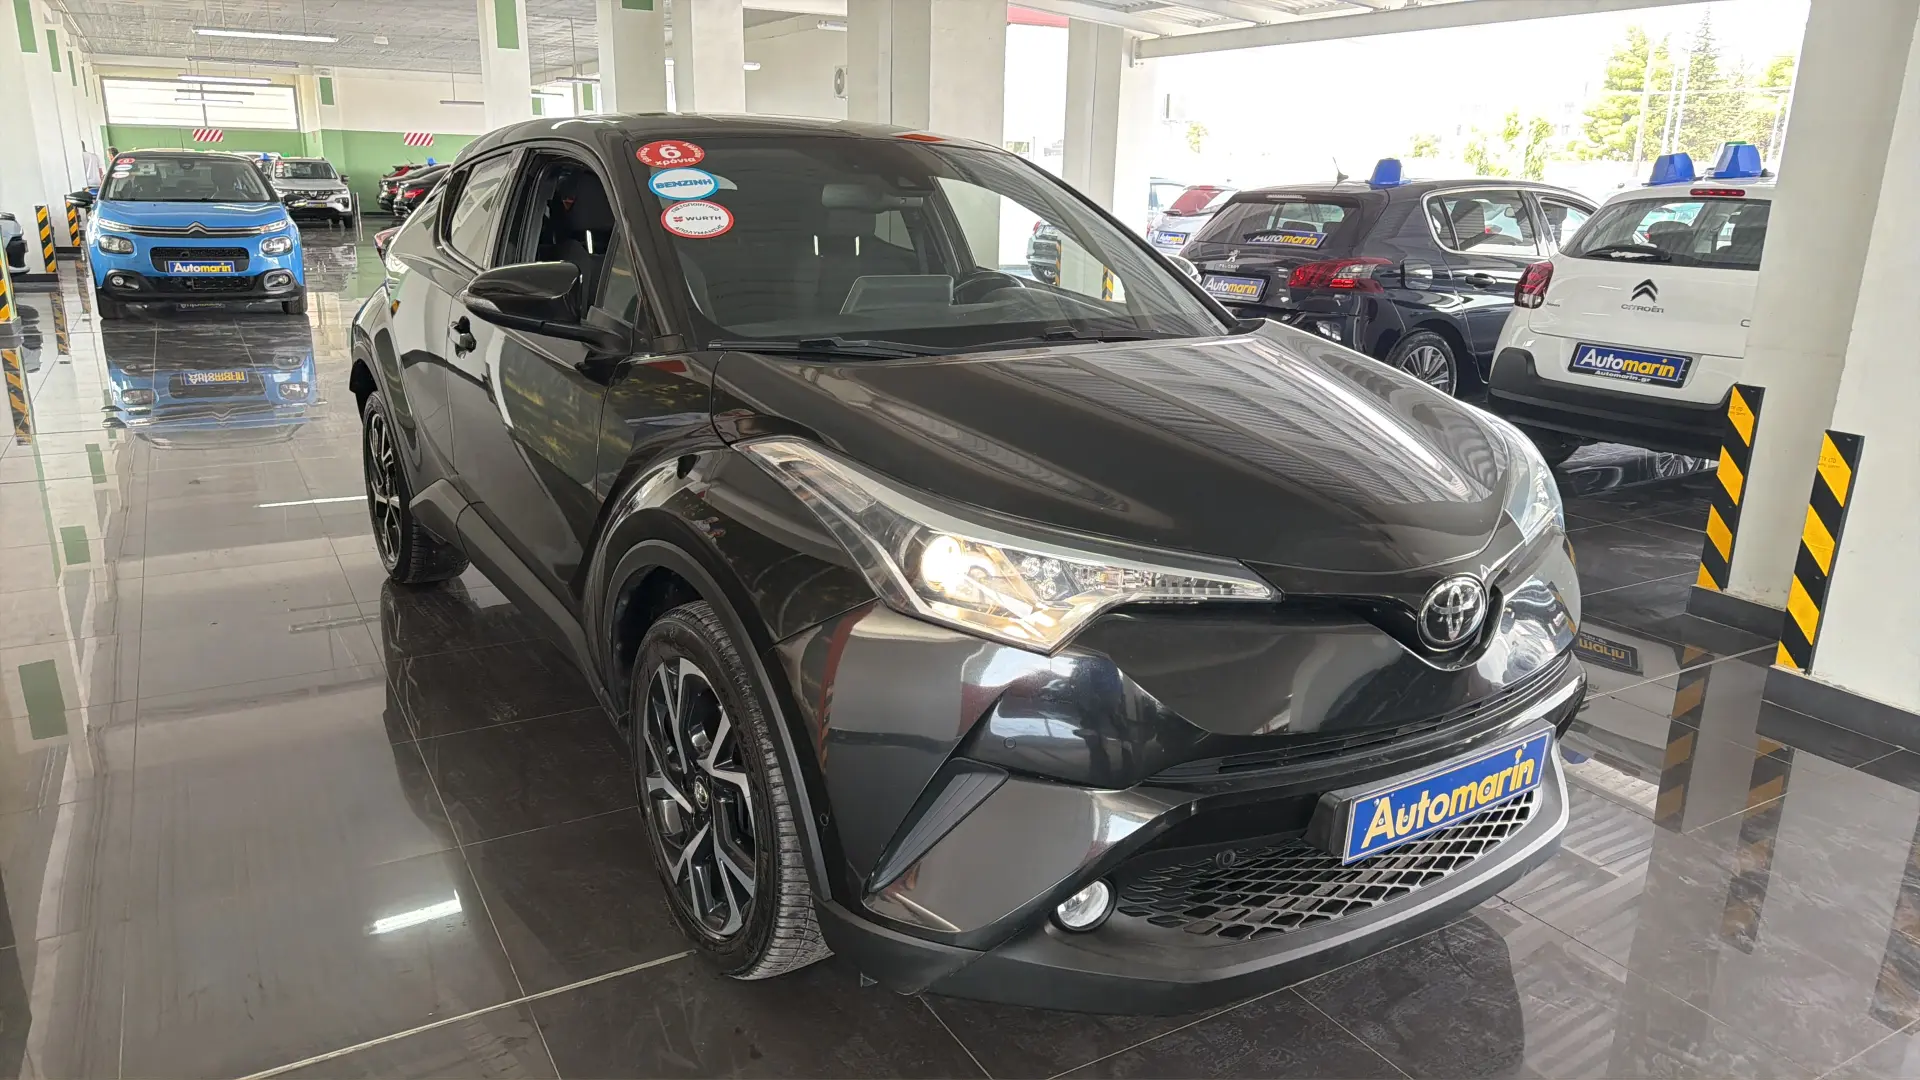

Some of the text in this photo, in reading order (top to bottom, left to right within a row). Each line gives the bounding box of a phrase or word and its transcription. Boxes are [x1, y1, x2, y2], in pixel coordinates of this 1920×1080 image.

[659, 146, 681, 159] 6
[655, 157, 697, 166] χρόνια
[1252, 233, 1318, 246] Automarin
[173, 262, 232, 273] Automarin
[1204, 276, 1258, 295] Automarin
[1580, 348, 1676, 378] Automarin
[1594, 369, 1652, 383] Automarin.gr
[1361, 748, 1536, 849] Automarin
